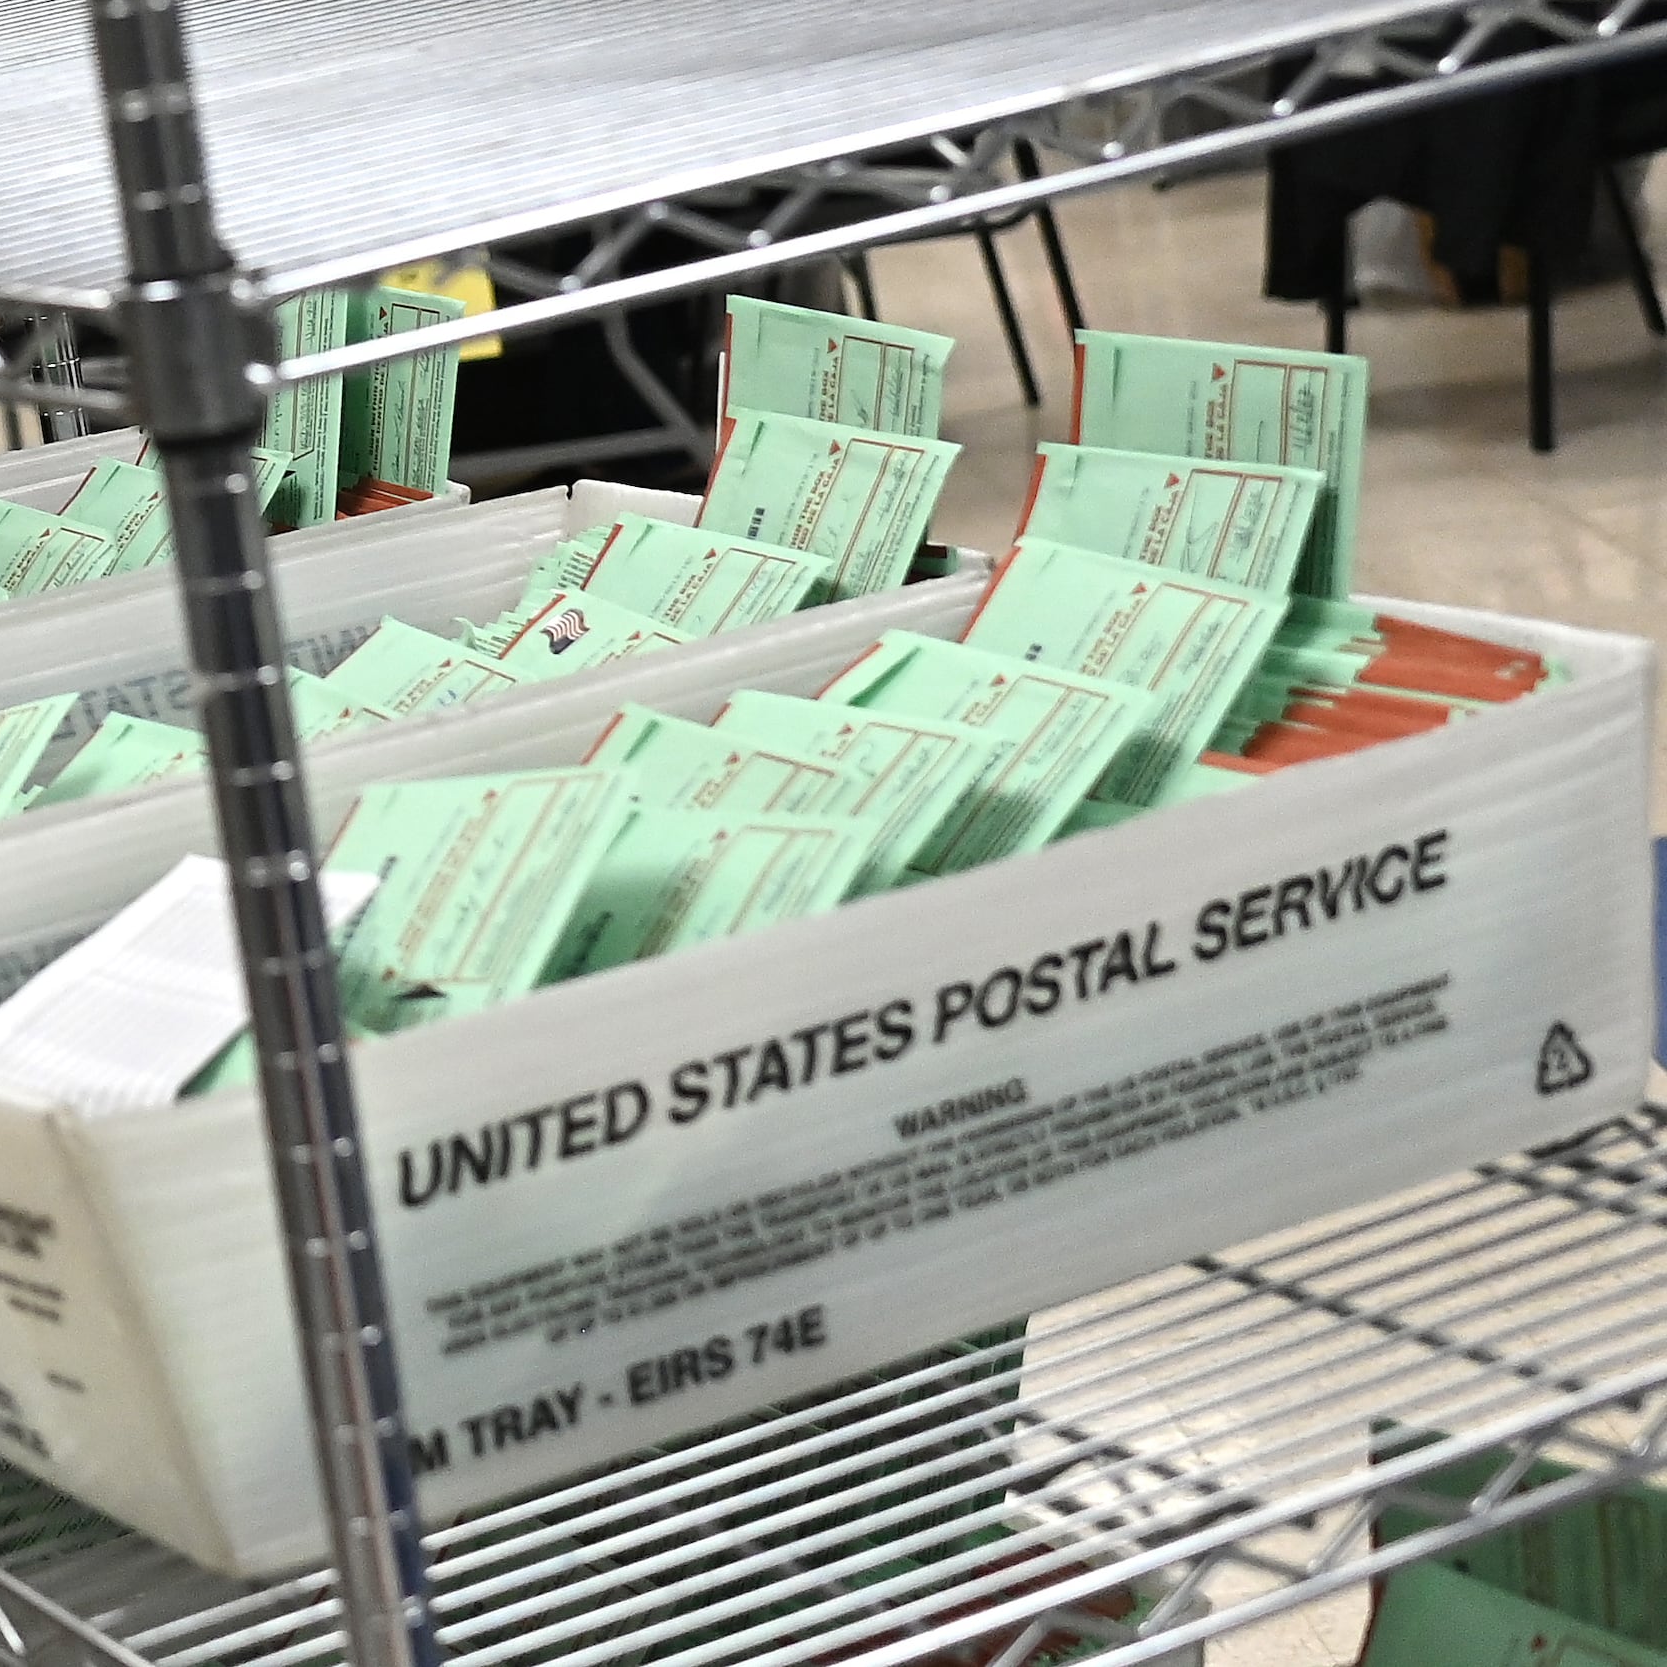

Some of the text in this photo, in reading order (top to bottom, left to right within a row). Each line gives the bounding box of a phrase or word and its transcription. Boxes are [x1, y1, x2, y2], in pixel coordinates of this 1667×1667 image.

[397, 830, 1452, 1206] UNITED STATES POSTAL SERVICE
[894, 1078, 1027, 1137] WARNING
[459, 1384, 585, 1461] TRAY
[627, 1333, 737, 1408] EIRS
[749, 1304, 829, 1368] 74E
